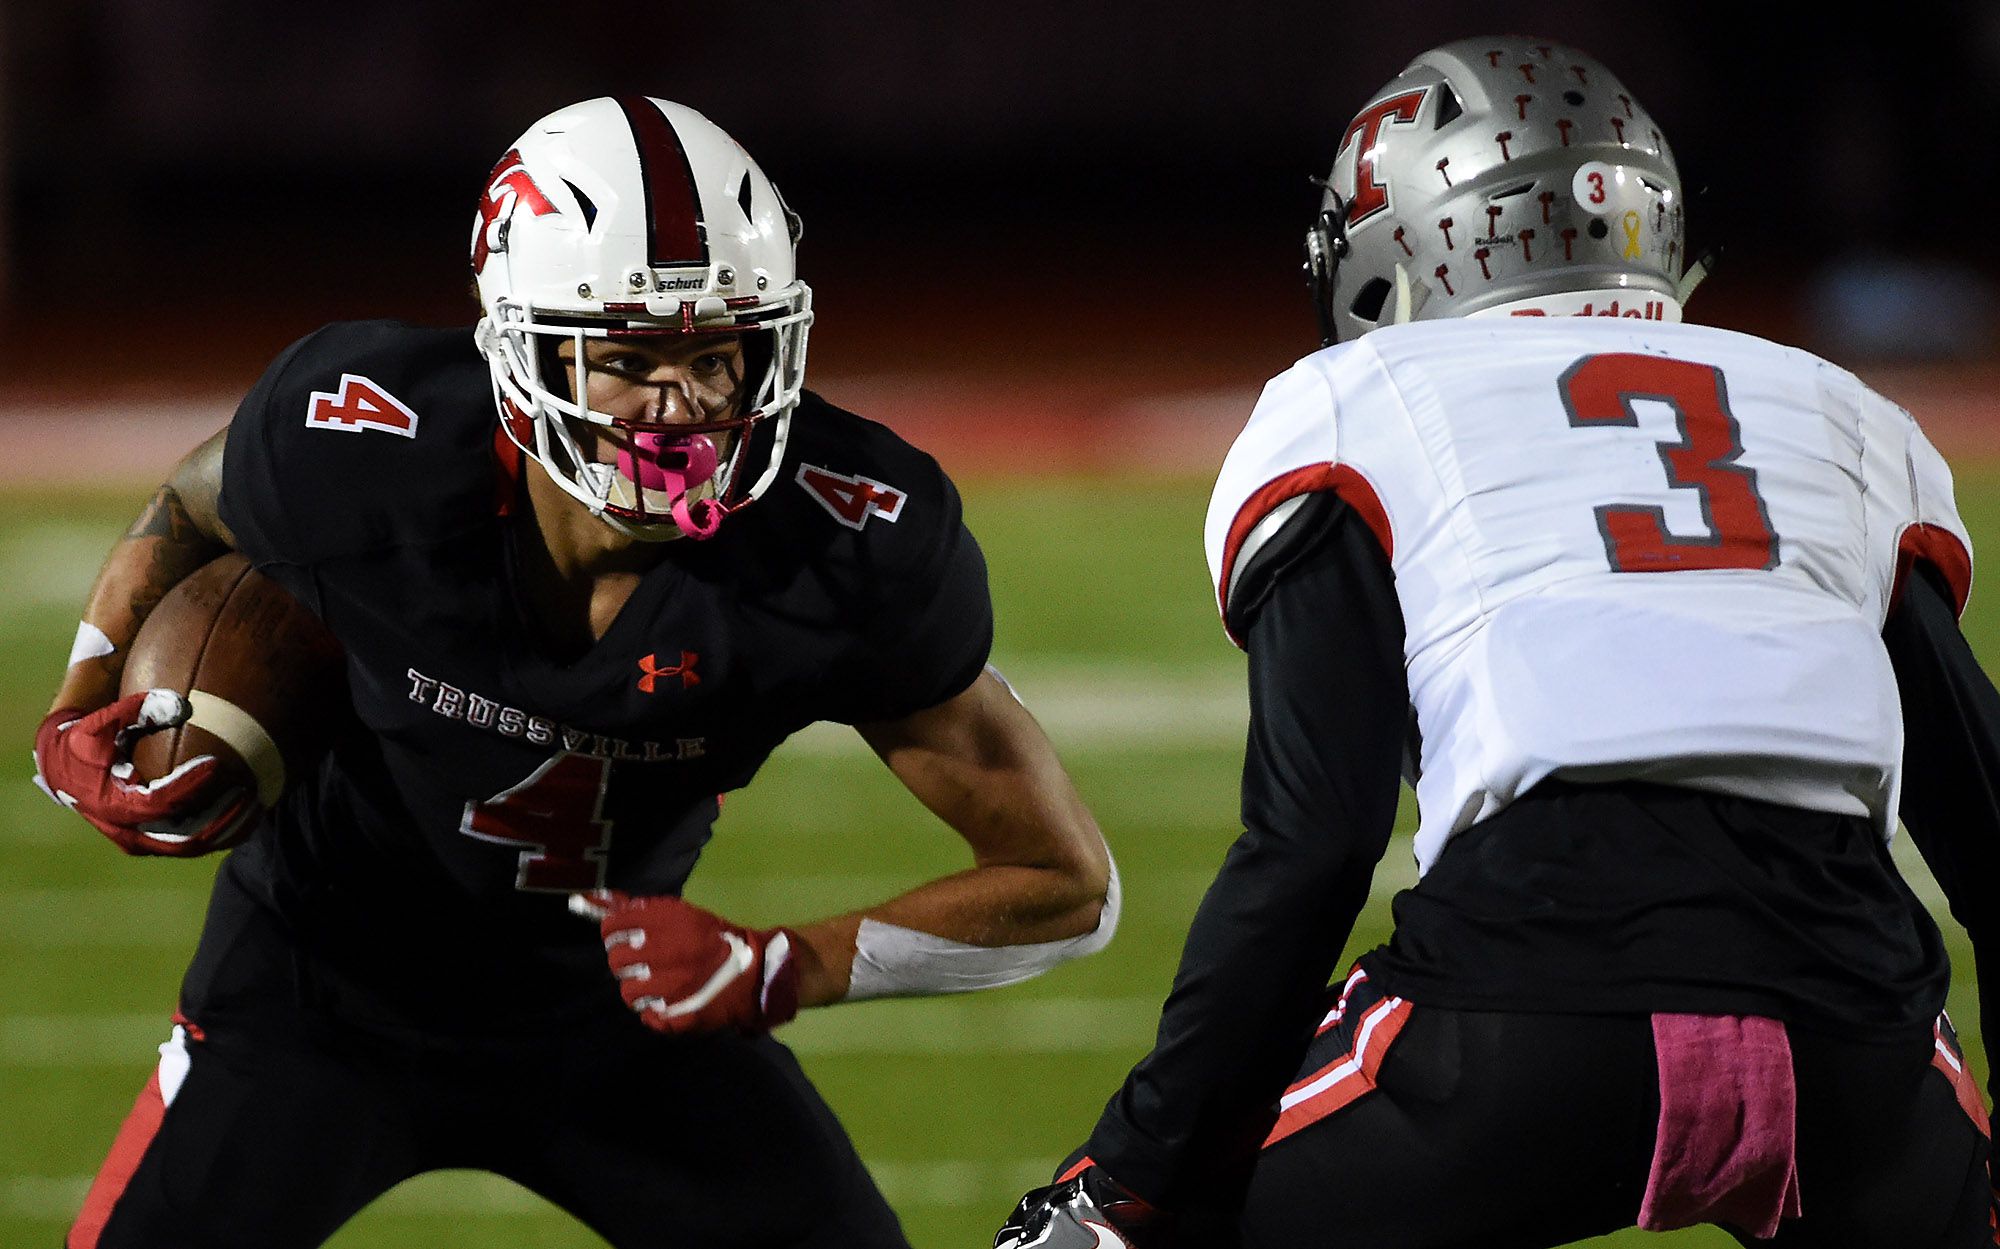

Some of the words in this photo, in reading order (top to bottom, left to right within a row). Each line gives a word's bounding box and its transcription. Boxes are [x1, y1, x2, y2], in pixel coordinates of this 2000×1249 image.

[1336, 86, 1430, 231] T
[1586, 171, 1606, 204] 3
[658, 277, 705, 290] schutt
[305, 373, 419, 439] 4
[794, 462, 908, 532] 4
[1556, 352, 1781, 573] 3
[407, 667, 706, 761] TRUSSVILLE
[459, 750, 614, 894] 4
